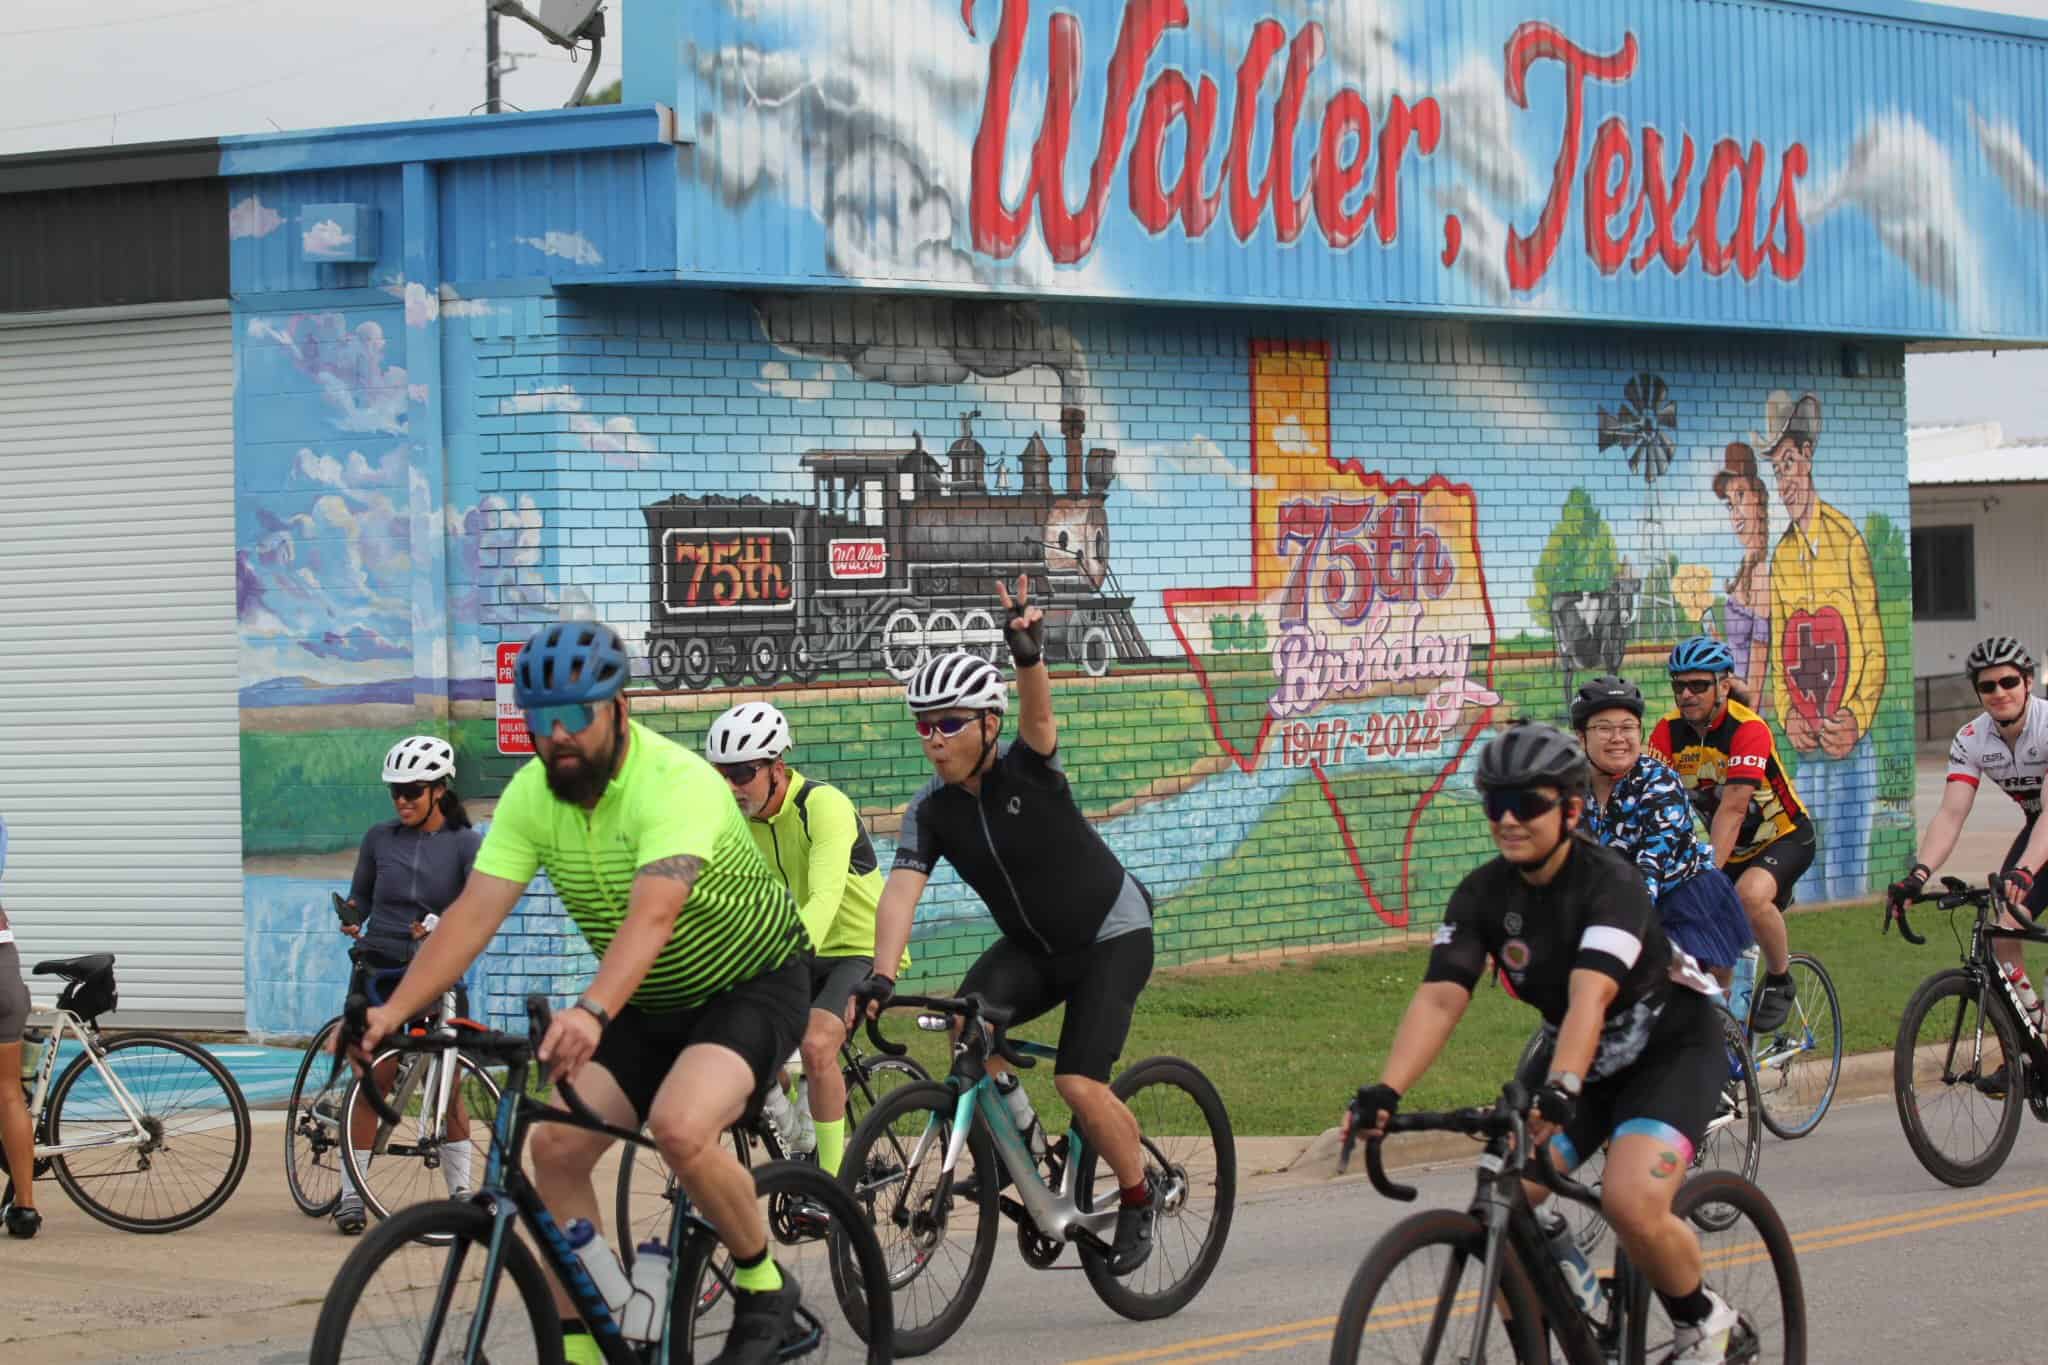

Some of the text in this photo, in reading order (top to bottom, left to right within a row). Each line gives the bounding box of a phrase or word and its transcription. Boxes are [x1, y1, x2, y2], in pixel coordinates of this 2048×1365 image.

[961, 0, 1809, 291] Waller, Texas
[675, 536, 793, 607] 75th
[1277, 494, 1455, 630] 75th
[1269, 602, 1504, 732] Birthday
